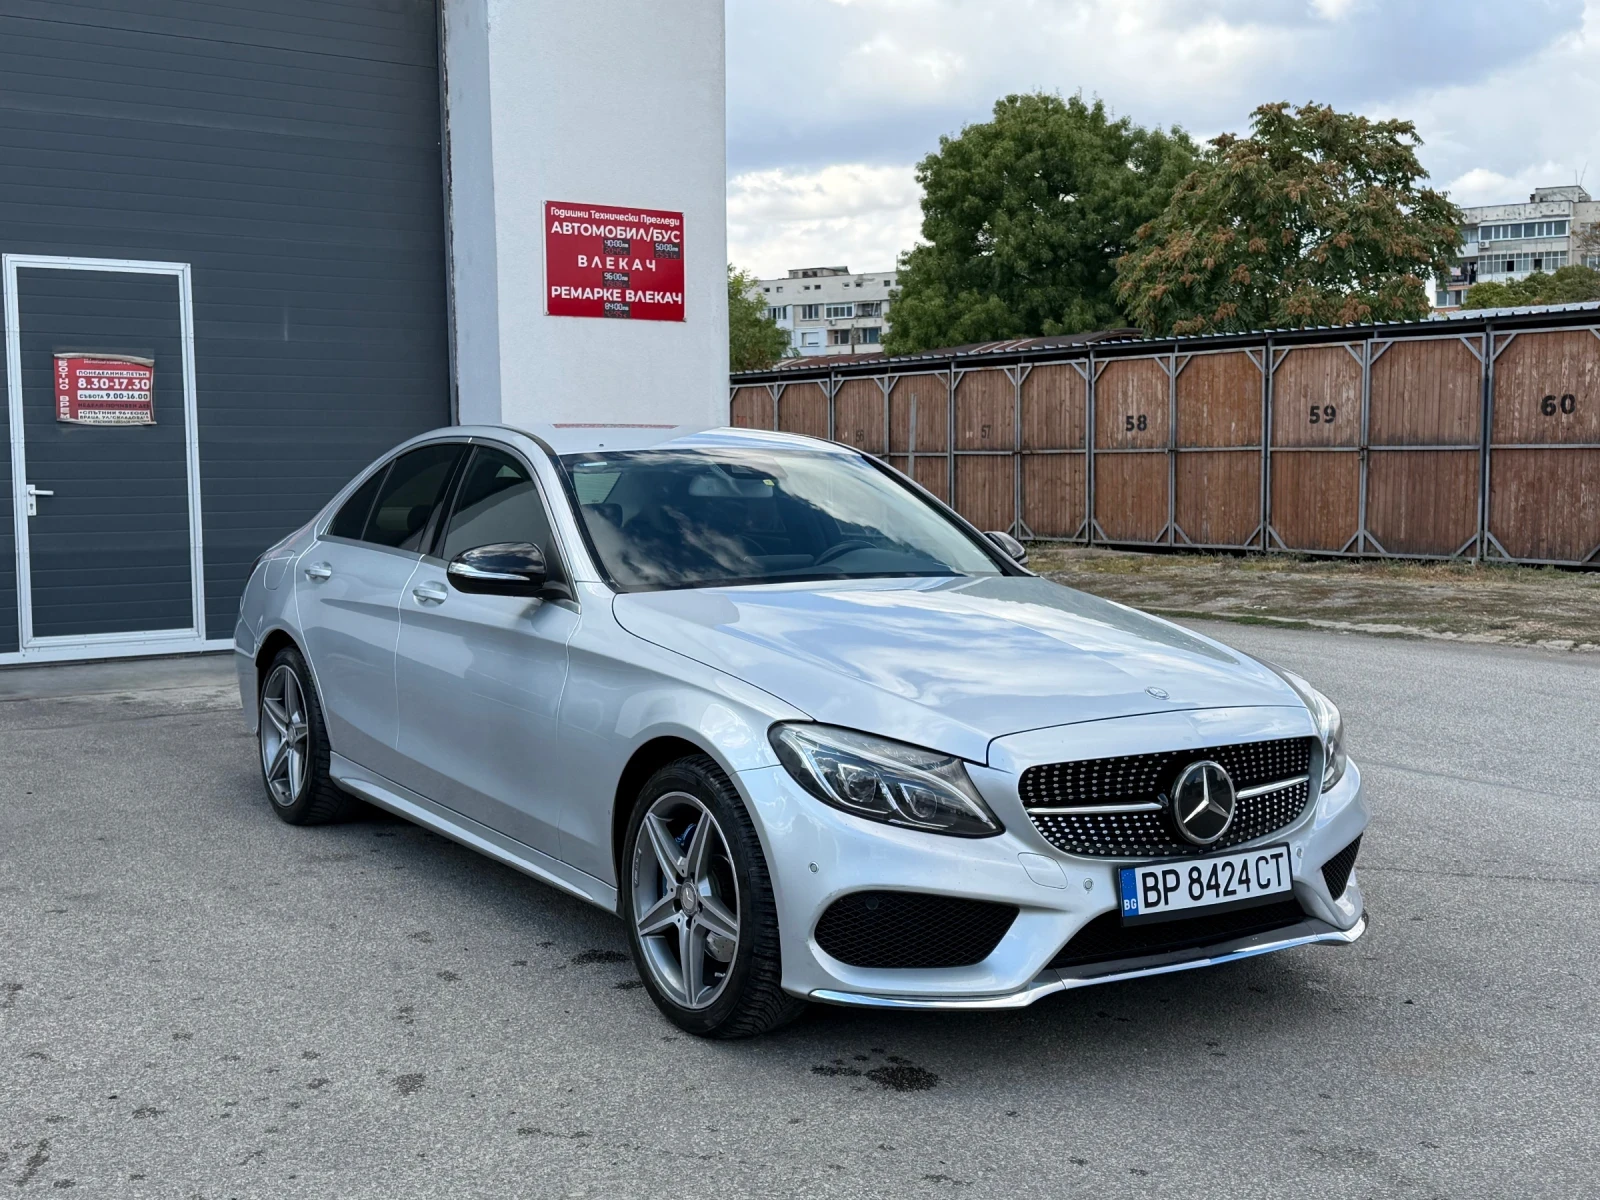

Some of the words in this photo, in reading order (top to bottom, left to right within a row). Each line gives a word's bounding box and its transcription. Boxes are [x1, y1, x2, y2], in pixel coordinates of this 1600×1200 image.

[550, 206, 589, 218] Годишни
[590, 210, 639, 223] Технически
[640, 214, 680, 228] Прегледи
[551, 221, 681, 243] АВТОМОБИЛ/БУС
[577, 255, 656, 272] ВЛЕКАЧ
[551, 286, 622, 301] РЕМАРКЕ
[625, 289, 682, 305] ВЛЕКАЧ
[78, 378, 150, 389] 8.30-17.30
[105, 392, 149, 400] 9.00-16.00
[1541, 393, 1576, 416] 60
[1125, 414, 1148, 432] 58
[1309, 404, 1337, 424] 59
[981, 424, 992, 439] 57
[1141, 868, 1181, 909] BP
[1188, 858, 1251, 902] 8424
[1255, 852, 1284, 890] CT
[1123, 898, 1138, 911] BG
